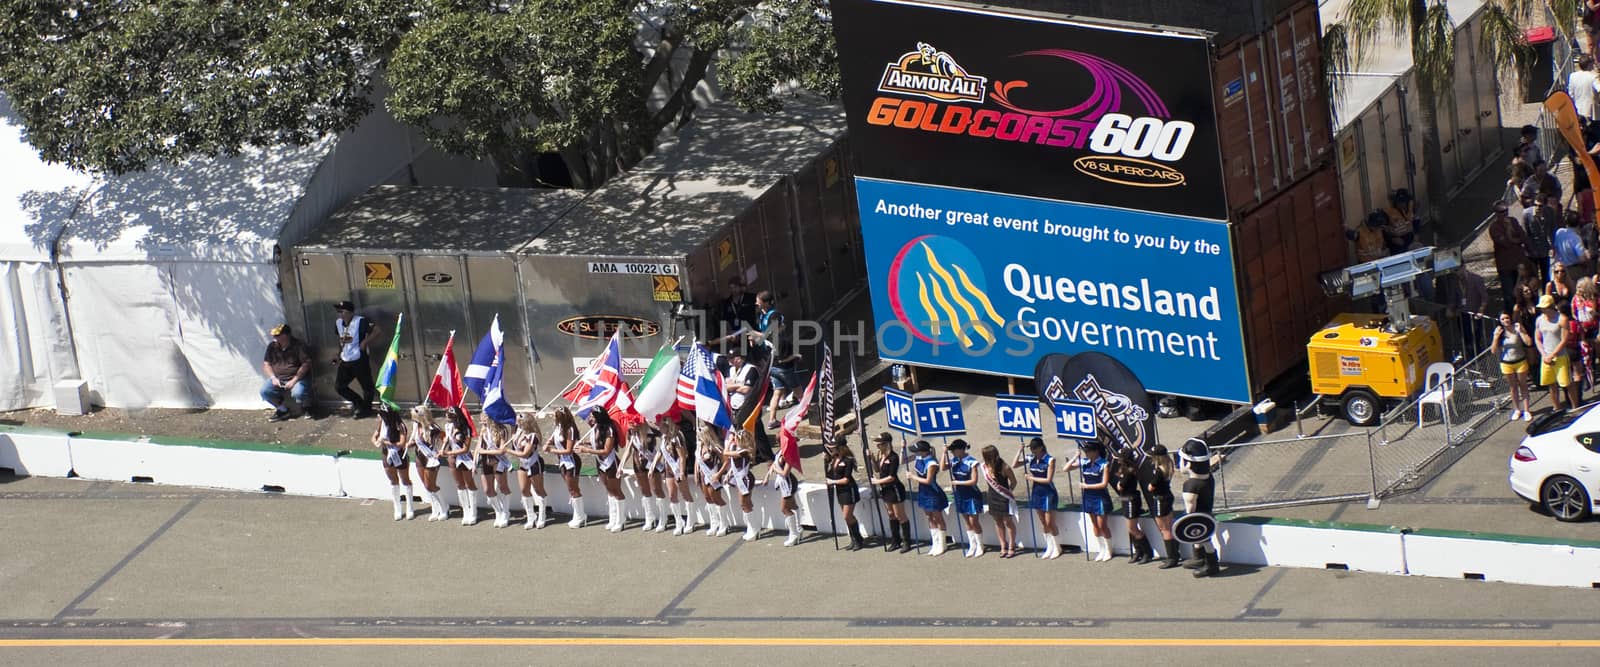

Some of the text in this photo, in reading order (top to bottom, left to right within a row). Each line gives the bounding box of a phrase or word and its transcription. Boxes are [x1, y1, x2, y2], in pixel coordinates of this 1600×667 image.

[1090, 113, 1195, 162] 600
[1080, 159, 1181, 181] V8 SUPERCARS
[875, 199, 1220, 255] Another great event brought to you by the
[592, 264, 618, 273] AMA
[625, 264, 657, 274] 10022
[1003, 263, 1221, 321] Queensland
[580, 320, 657, 333] SUPERARS
[1018, 307, 1221, 360] Government
[889, 399, 912, 425] M8
[999, 407, 1040, 430] CAN
